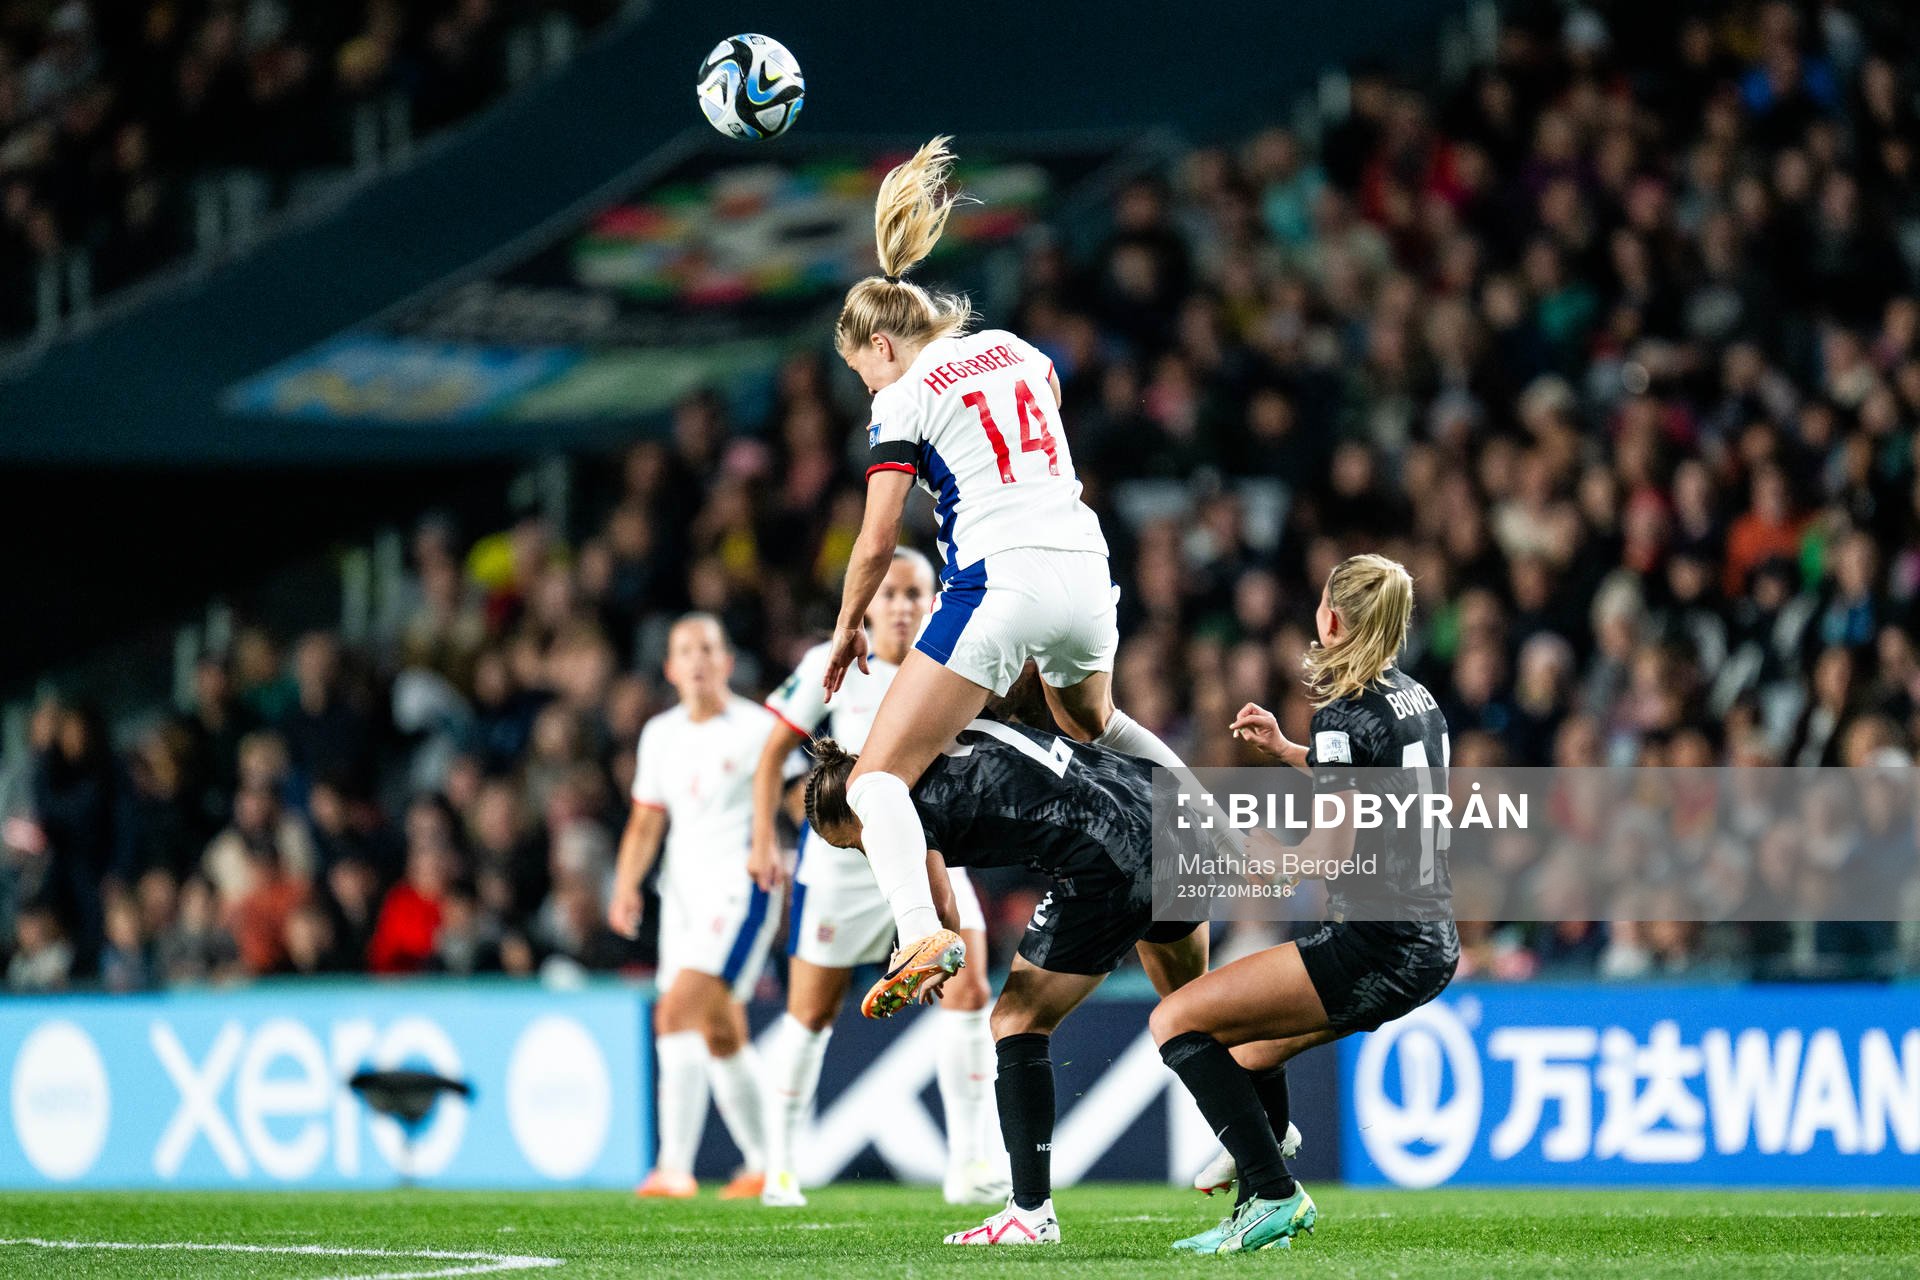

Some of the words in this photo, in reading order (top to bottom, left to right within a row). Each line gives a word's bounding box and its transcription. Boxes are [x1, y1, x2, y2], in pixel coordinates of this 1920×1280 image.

[961, 379, 1061, 485] 14
[1384, 683, 1439, 720] BOWE
[148, 1016, 470, 1181] xero
[1487, 1019, 1706, 1162] 万达
